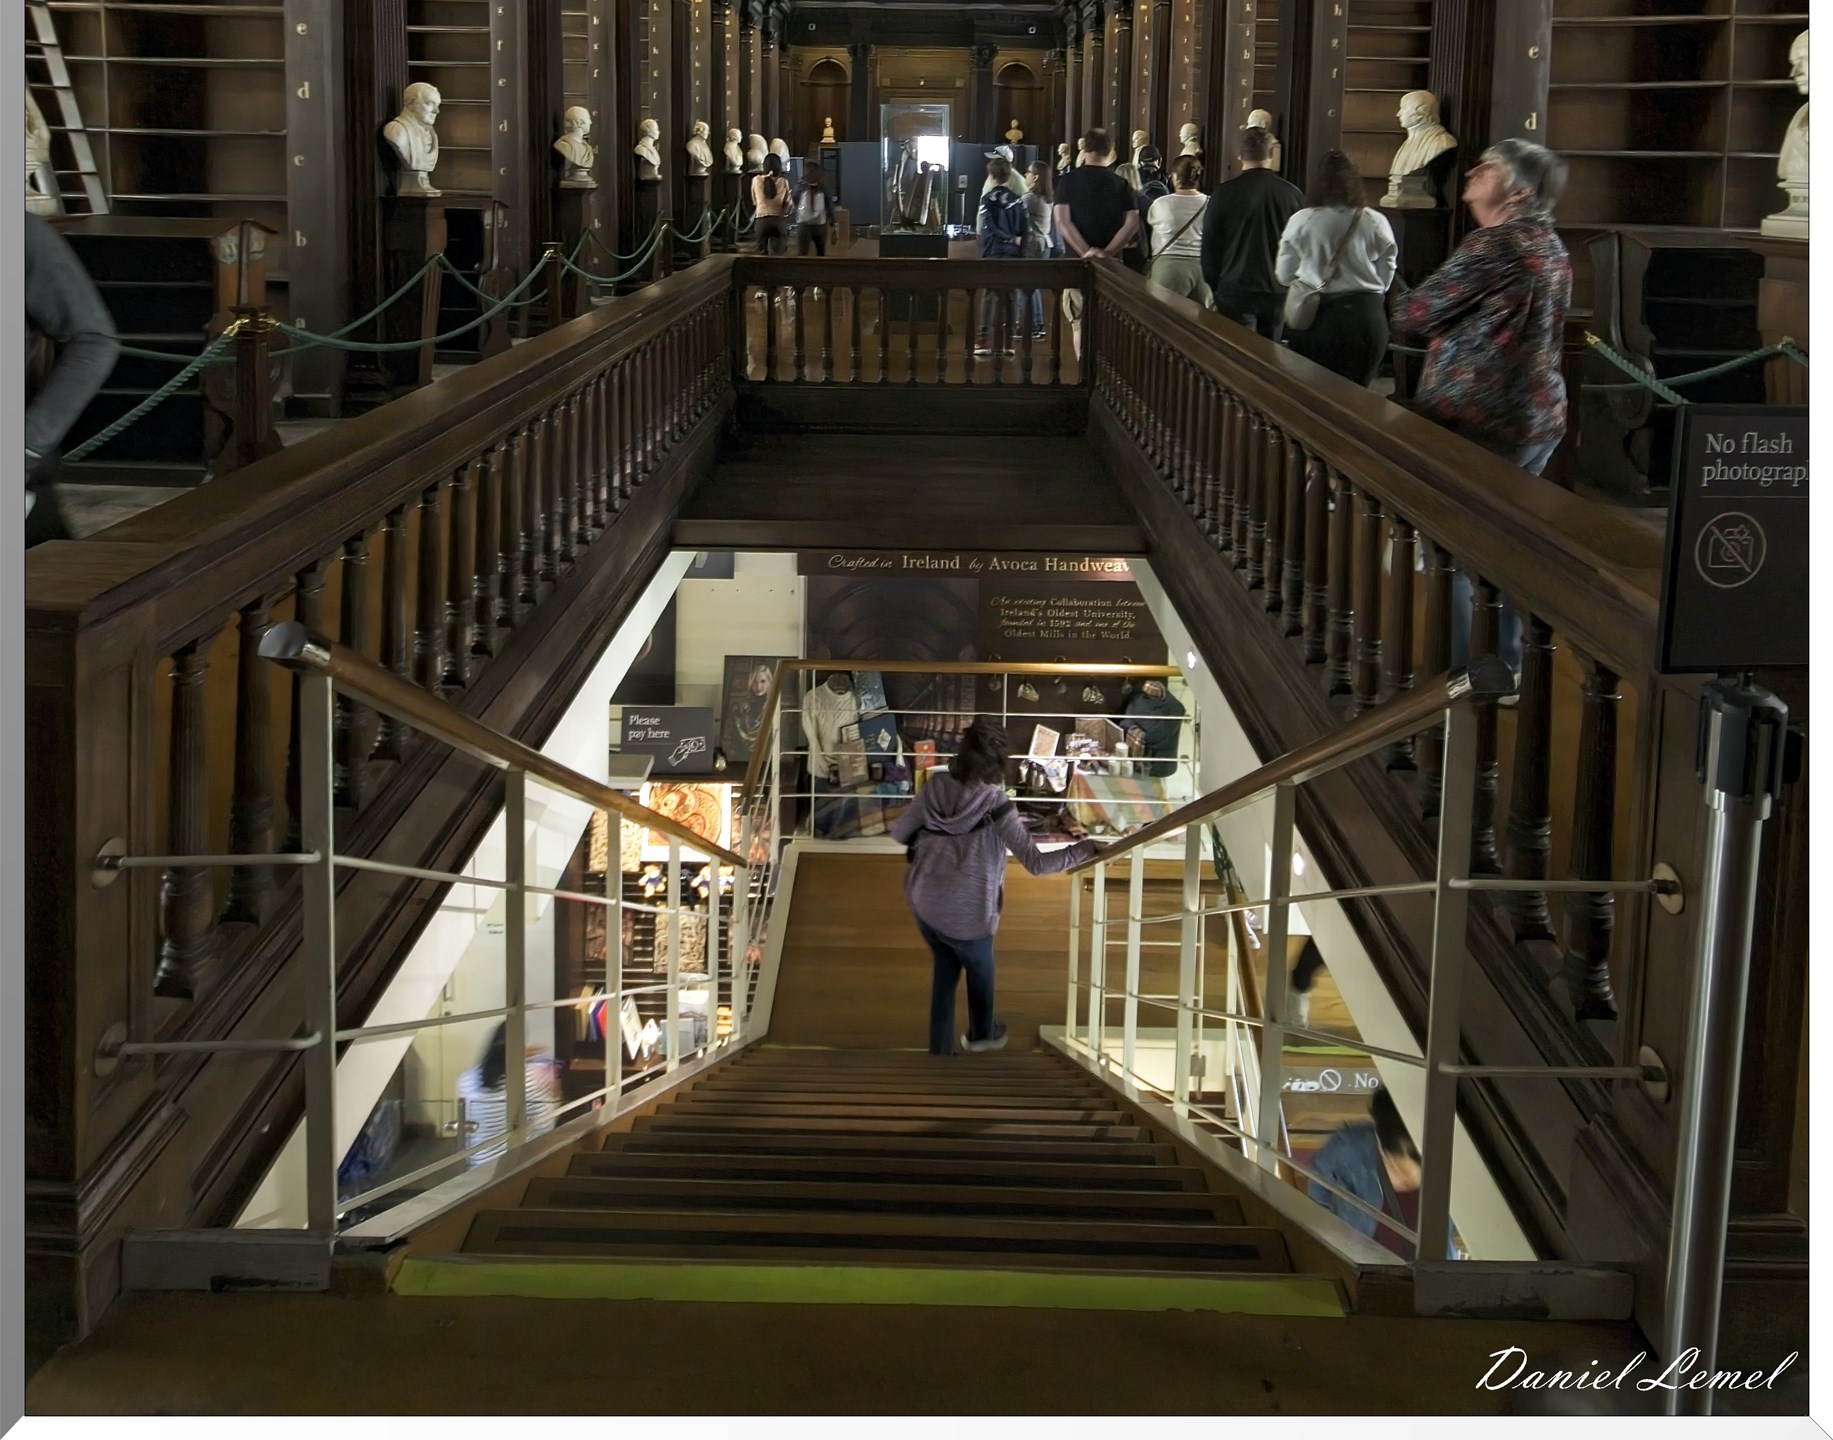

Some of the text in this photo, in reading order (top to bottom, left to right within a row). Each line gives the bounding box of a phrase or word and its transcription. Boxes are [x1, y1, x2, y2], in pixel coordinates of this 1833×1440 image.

[296, 23, 308, 35] e
[1528, 44, 1539, 59] e
[297, 82, 310, 100] d
[499, 119, 508, 132] d
[1525, 113, 1537, 130] d
[296, 231, 307, 247] b
[1705, 431, 1793, 454] No flash
[1700, 459, 1808, 488] photograp
[828, 554, 880, 571] Crafted
[880, 560, 893, 569] in
[902, 555, 960, 569] Ireland
[968, 558, 984, 573] by
[989, 557, 1038, 571] Avoca
[1050, 597, 1112, 607] Collaboration
[1047, 609, 1079, 618] Oldest
[1004, 629, 1036, 638] Oldest
[1040, 630, 1065, 639] Mills
[629, 714, 661, 726] Please
[628, 727, 671, 742] pay here
[1354, 1072, 1379, 1089] No
